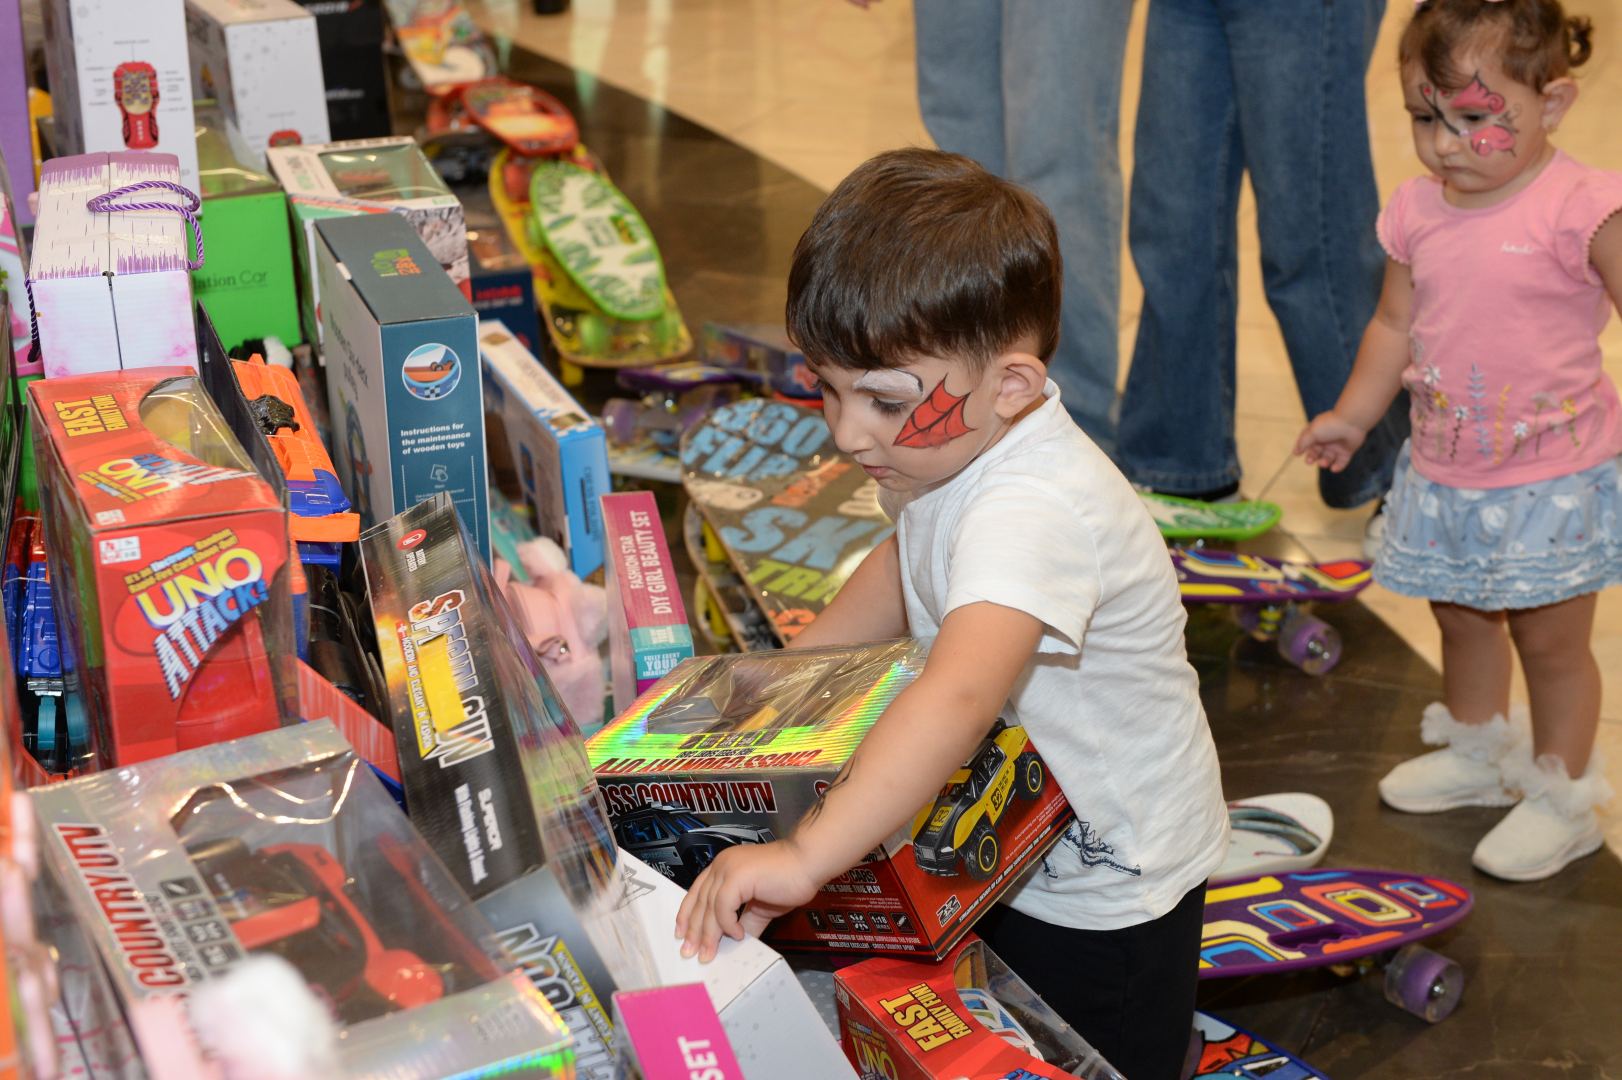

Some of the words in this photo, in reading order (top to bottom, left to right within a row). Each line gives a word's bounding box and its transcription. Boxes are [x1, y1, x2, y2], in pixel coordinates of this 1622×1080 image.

[54, 399, 105, 437] FAST
[98, 407, 128, 432] FAMILY
[400, 425, 450, 436] Instructions
[711, 398, 833, 458] 360
[402, 447, 412, 455] of
[414, 444, 446, 453] wooden
[447, 441, 466, 450] toys
[418, 432, 471, 444] maintenance
[681, 426, 800, 481] FLIP
[98, 458, 180, 496] UNO
[630, 511, 652, 528] SET
[620, 535, 638, 554] STAR
[636, 528, 661, 567] BEAUTY
[136, 548, 263, 629] UNO
[624, 552, 644, 589] FASHION
[646, 568, 668, 594] GIRL
[651, 596, 672, 614] DIY
[153, 580, 270, 700] ATTACK!
[408, 663, 421, 677] AND
[646, 658, 680, 671] YOUR
[599, 784, 638, 817] OSS
[636, 782, 734, 814] COUNTRY
[730, 780, 778, 814] UTV
[55, 824, 122, 868] UTV
[82, 873, 189, 988] COUNTRY
[908, 982, 942, 1010] FUN!
[879, 992, 954, 1052] FAST
[928, 1004, 974, 1040] FAMILY
[677, 1036, 724, 1080] SET
[852, 1036, 898, 1080] UNO
